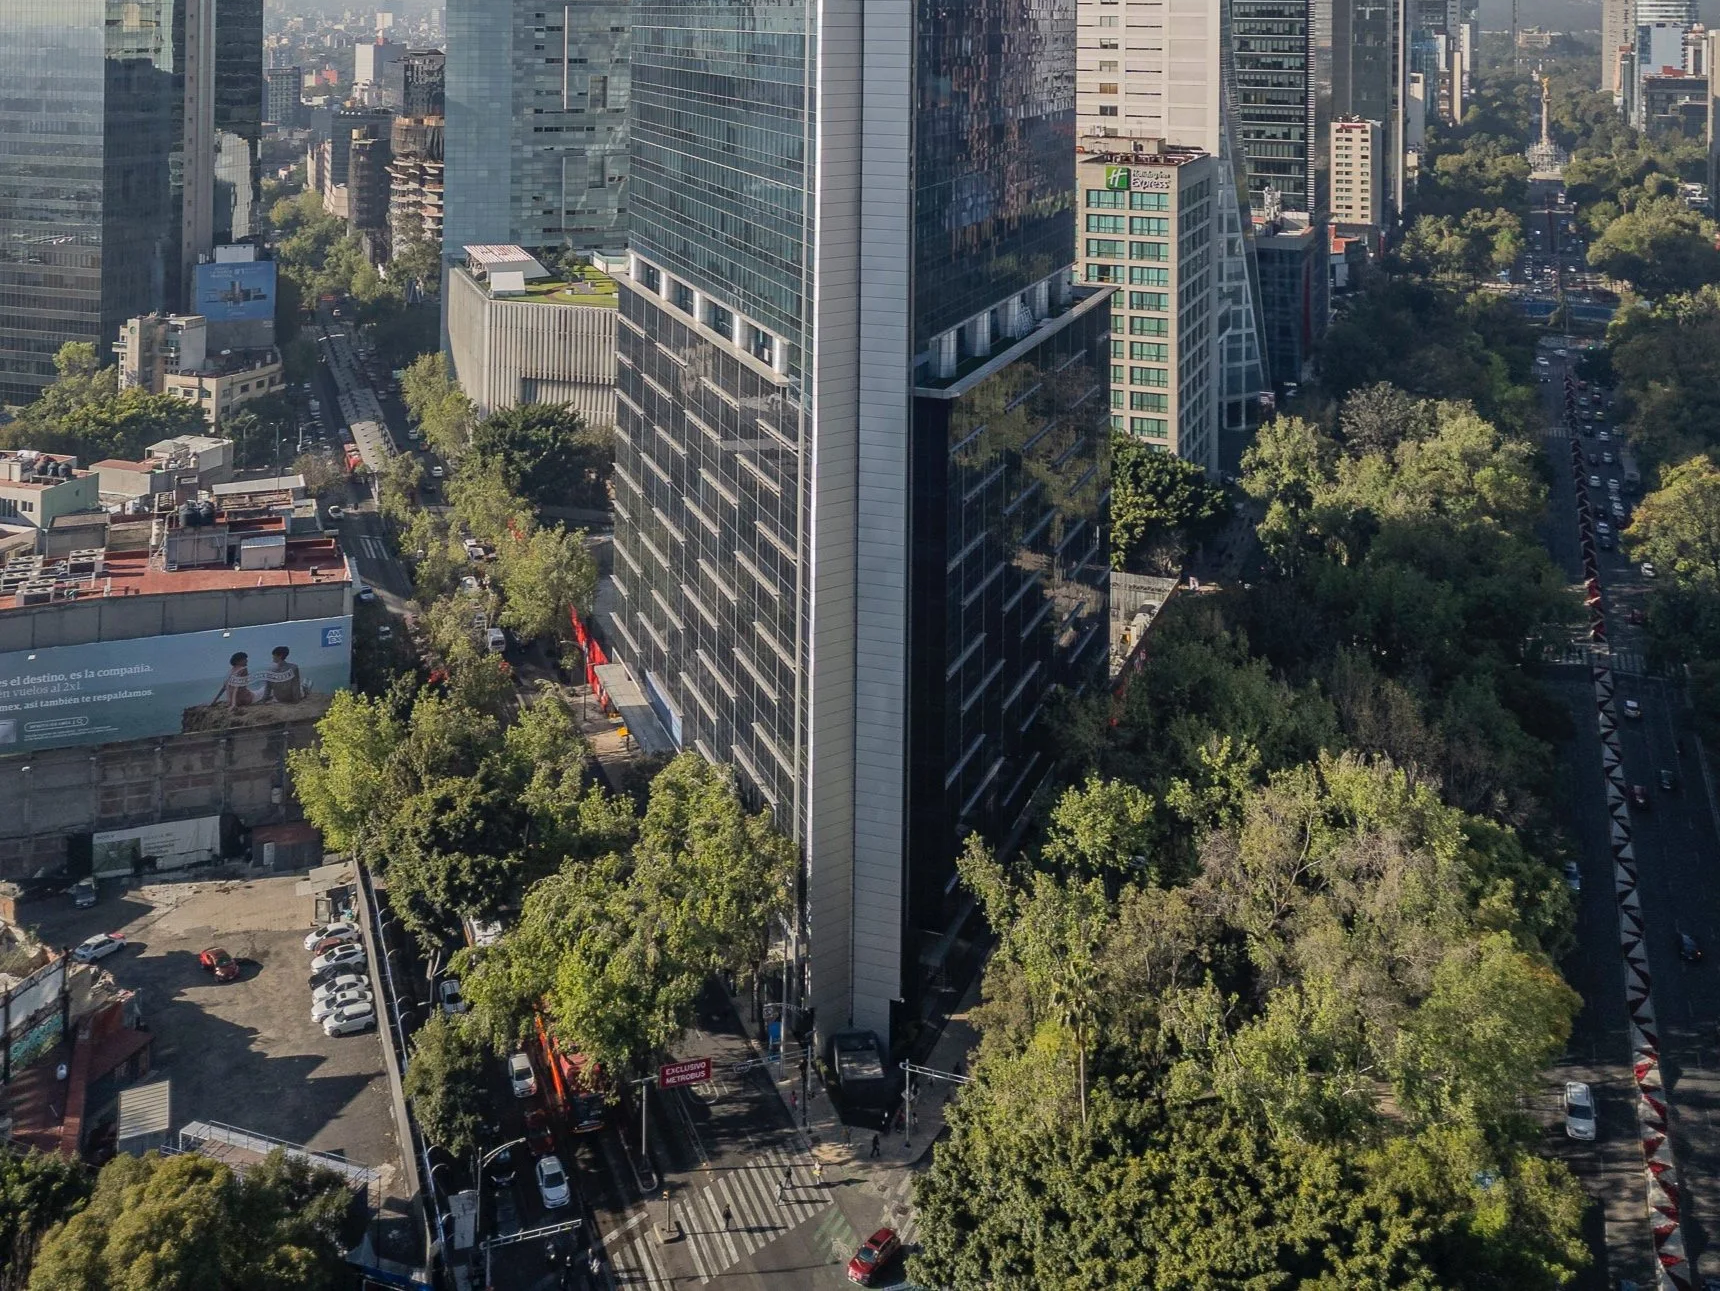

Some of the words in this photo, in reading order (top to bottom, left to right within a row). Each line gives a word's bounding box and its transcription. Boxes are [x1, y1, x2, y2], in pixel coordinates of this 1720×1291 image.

[1132, 178, 1171, 190] Express
[10, 676, 21, 686] el
[23, 673, 67, 685] destino,
[70, 671, 82, 680] es
[84, 669, 95, 679] la
[97, 663, 154, 677] compañía.
[13, 685, 49, 697] vuelos
[50, 683, 60, 693] al
[24, 700, 38, 709] así
[665, 1061, 707, 1076] EXCLUSIVO
[665, 1070, 706, 1085] METROBUS
